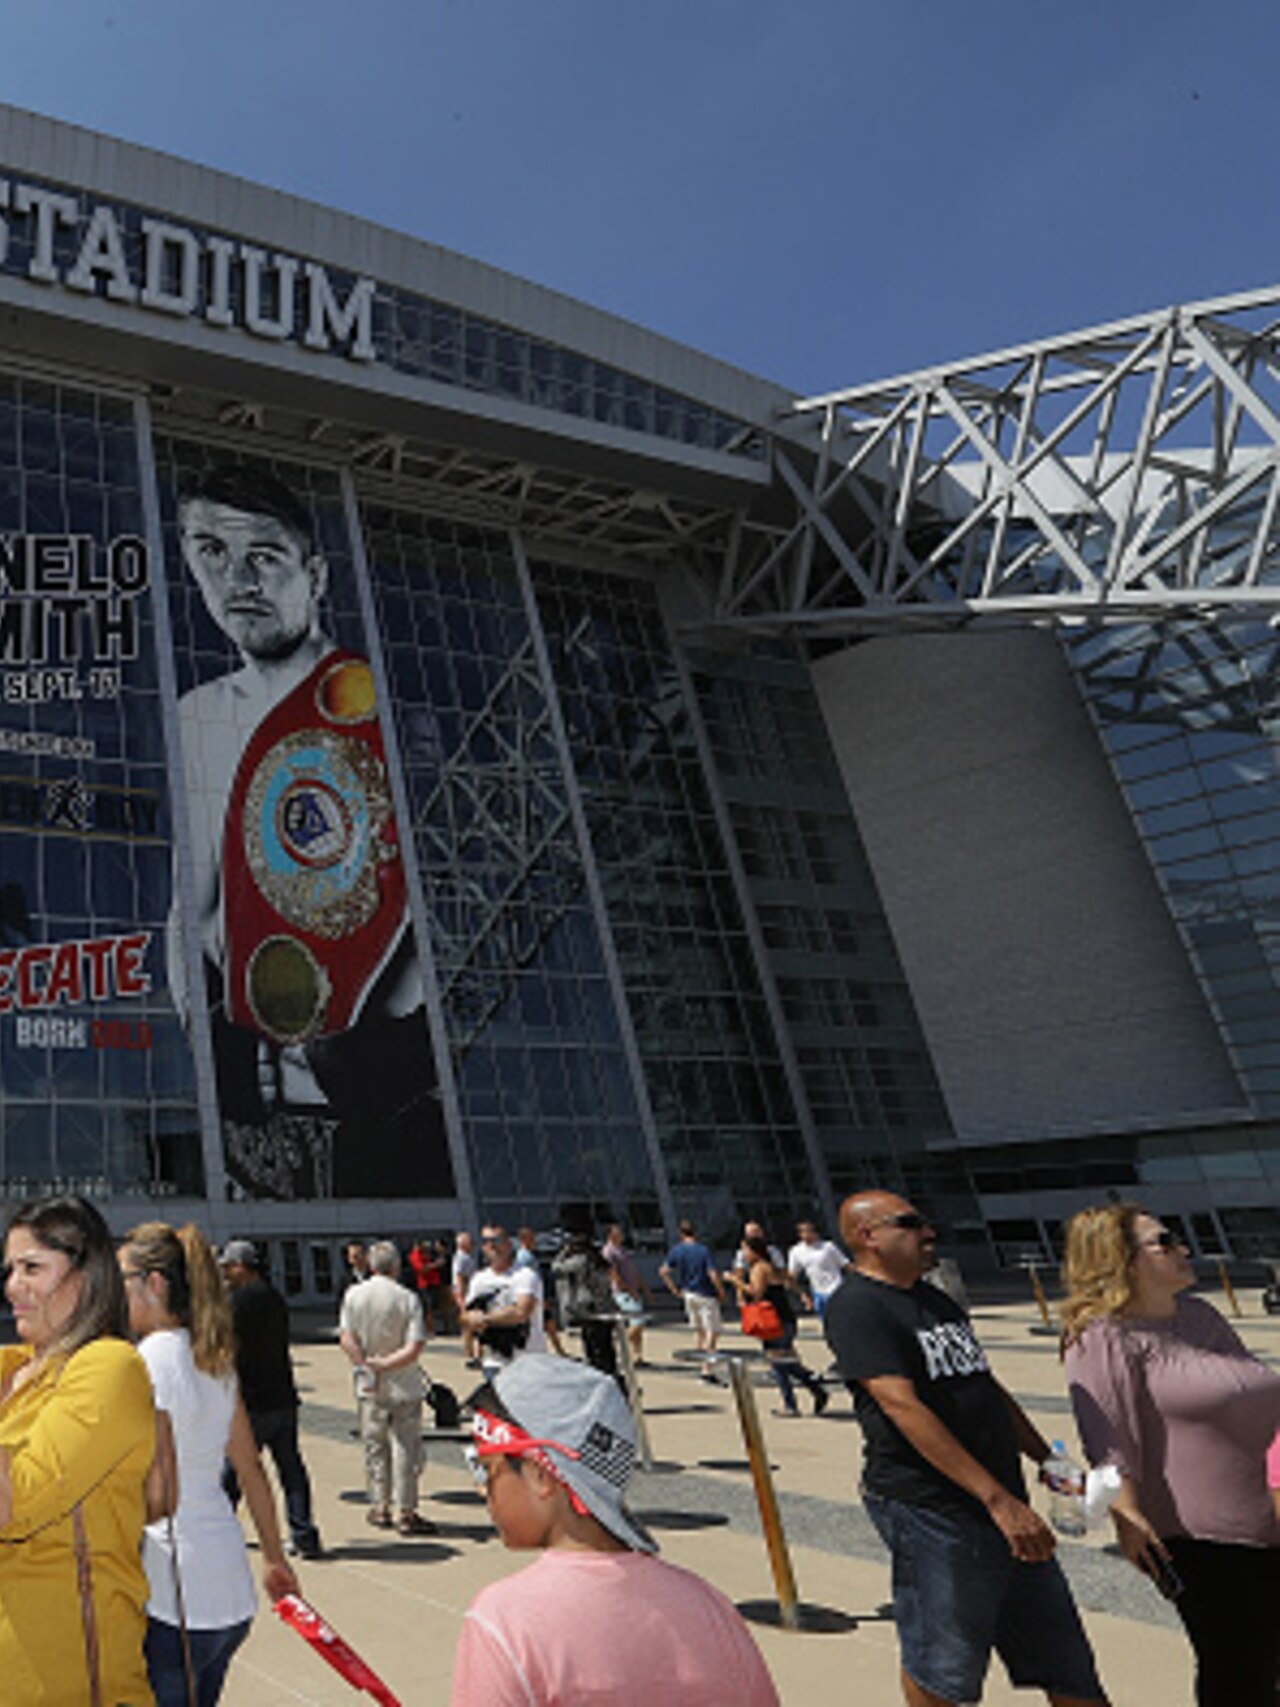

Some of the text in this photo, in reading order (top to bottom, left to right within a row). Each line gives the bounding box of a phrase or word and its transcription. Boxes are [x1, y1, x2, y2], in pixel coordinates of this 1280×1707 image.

[4, 668, 83, 703] SEPT.
[16, 1016, 154, 1050] BORN BOLD
